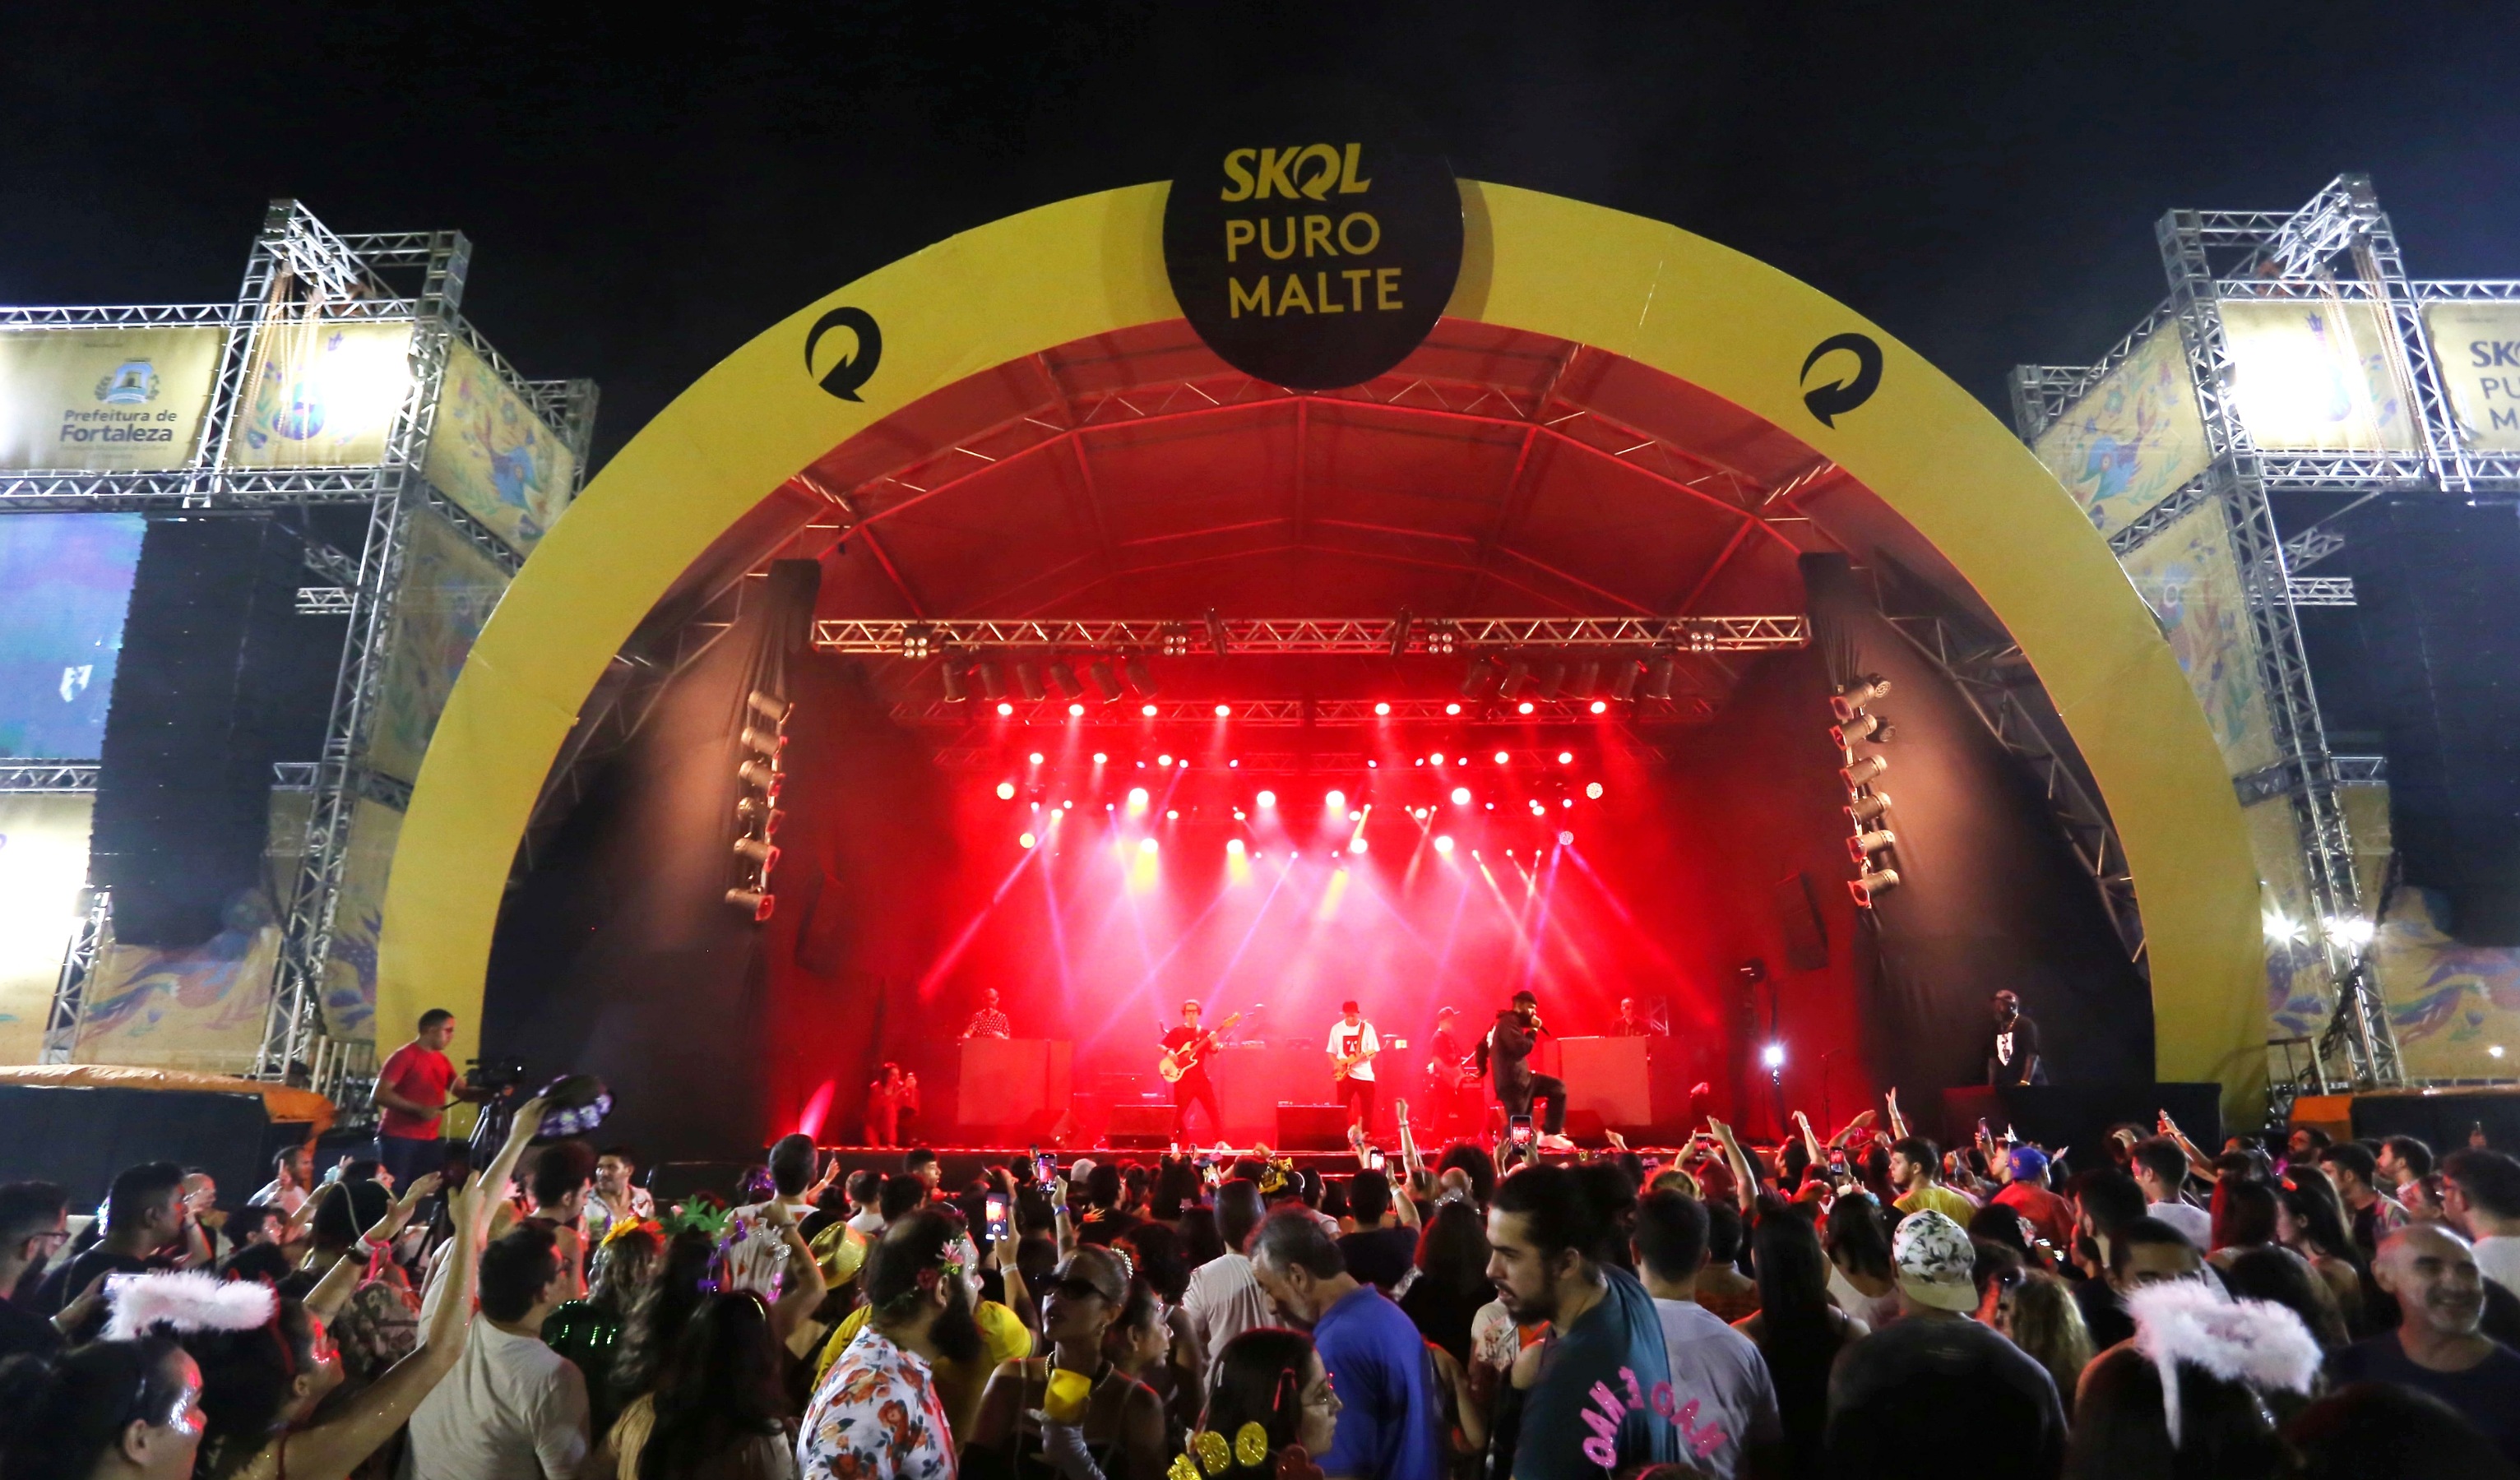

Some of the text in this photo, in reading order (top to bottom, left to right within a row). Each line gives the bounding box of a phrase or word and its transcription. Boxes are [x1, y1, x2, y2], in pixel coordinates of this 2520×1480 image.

[1221, 142, 1372, 202] SKOL
[1225, 212, 1381, 262] PURO
[1229, 268, 1403, 318] MALTE
[2469, 340, 2520, 368] SK
[59, 423, 173, 442] Fortaleza
[63, 409, 178, 423] Prefeitura de
